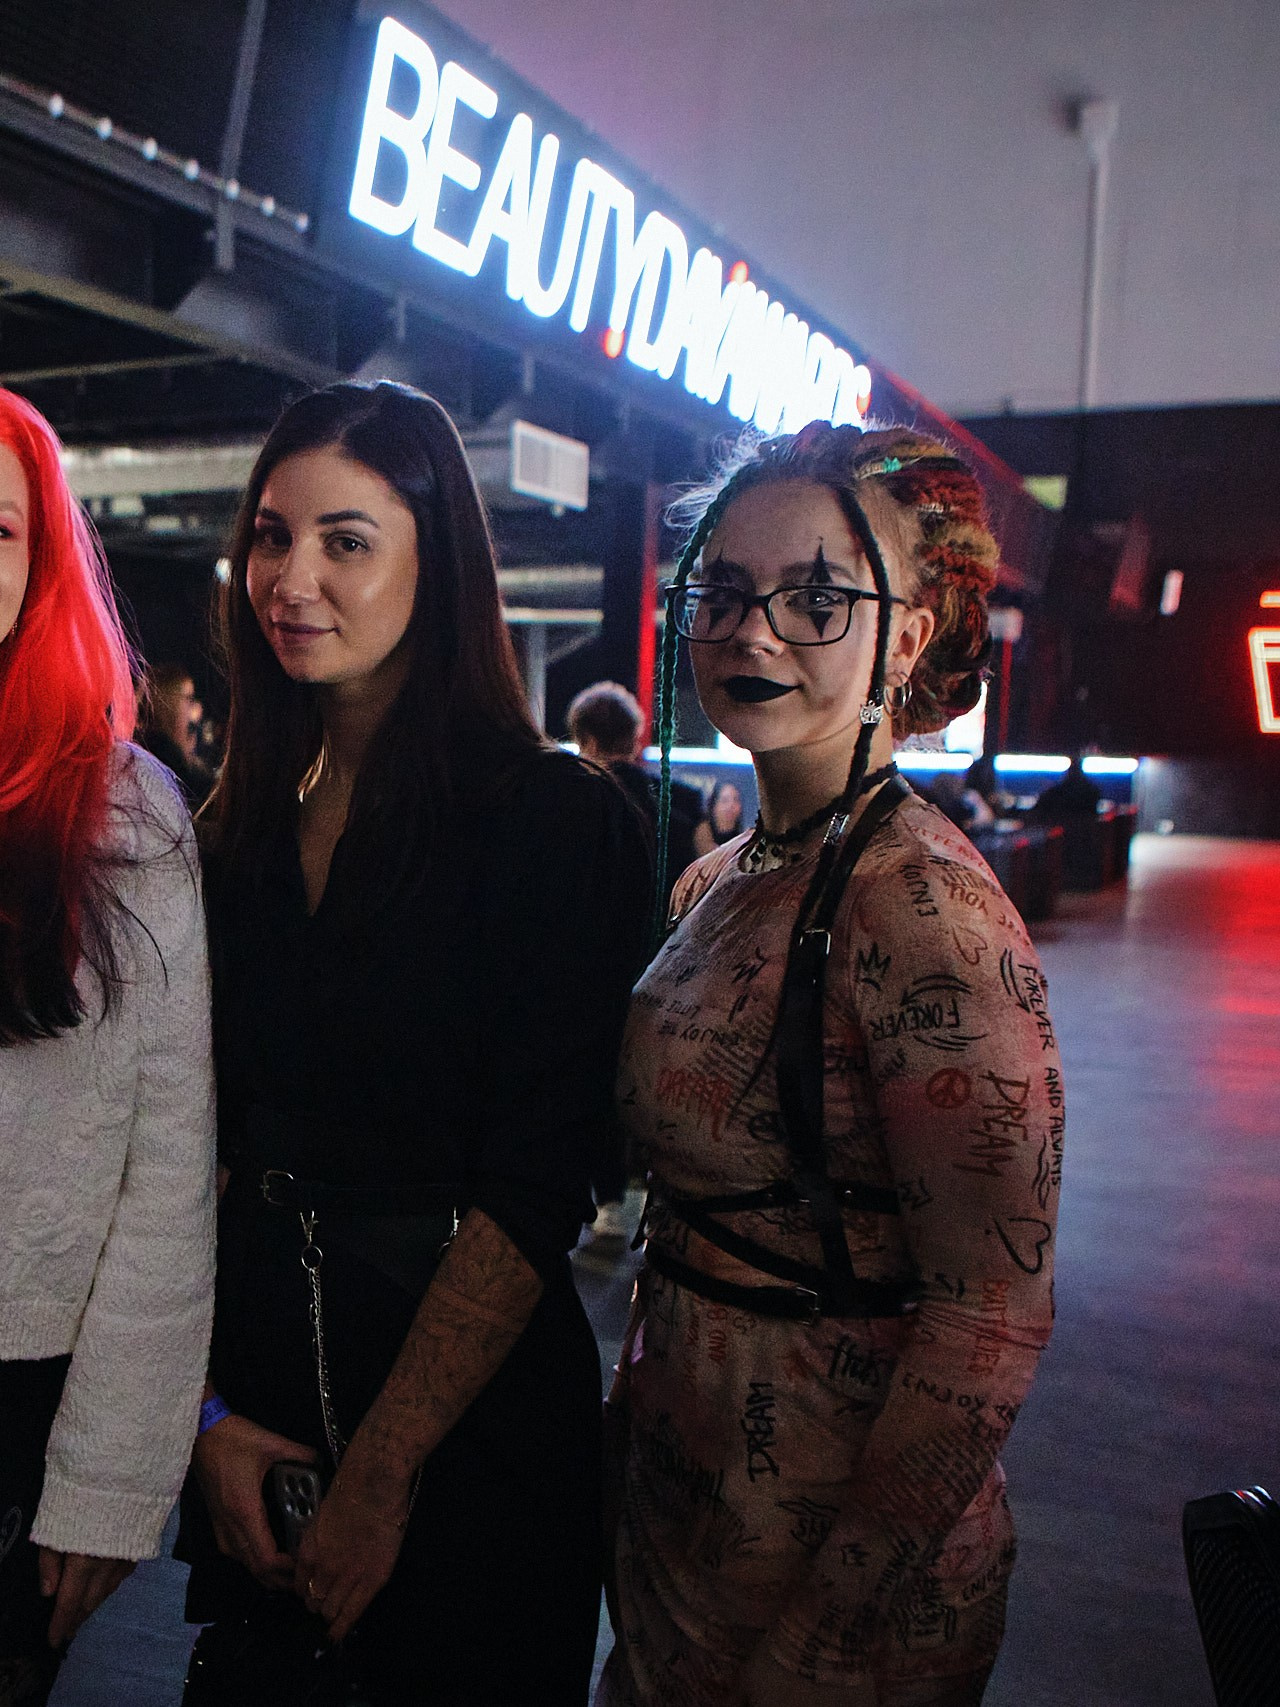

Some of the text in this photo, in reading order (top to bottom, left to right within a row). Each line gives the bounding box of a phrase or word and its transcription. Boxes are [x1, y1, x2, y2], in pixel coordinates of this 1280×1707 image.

[869, 999, 960, 1042] FOREVER
[953, 1069, 1031, 1178] DREAM
[1018, 965, 1065, 1187] FOREVER AND ALWAYS
[741, 1382, 780, 1483] DREAM
